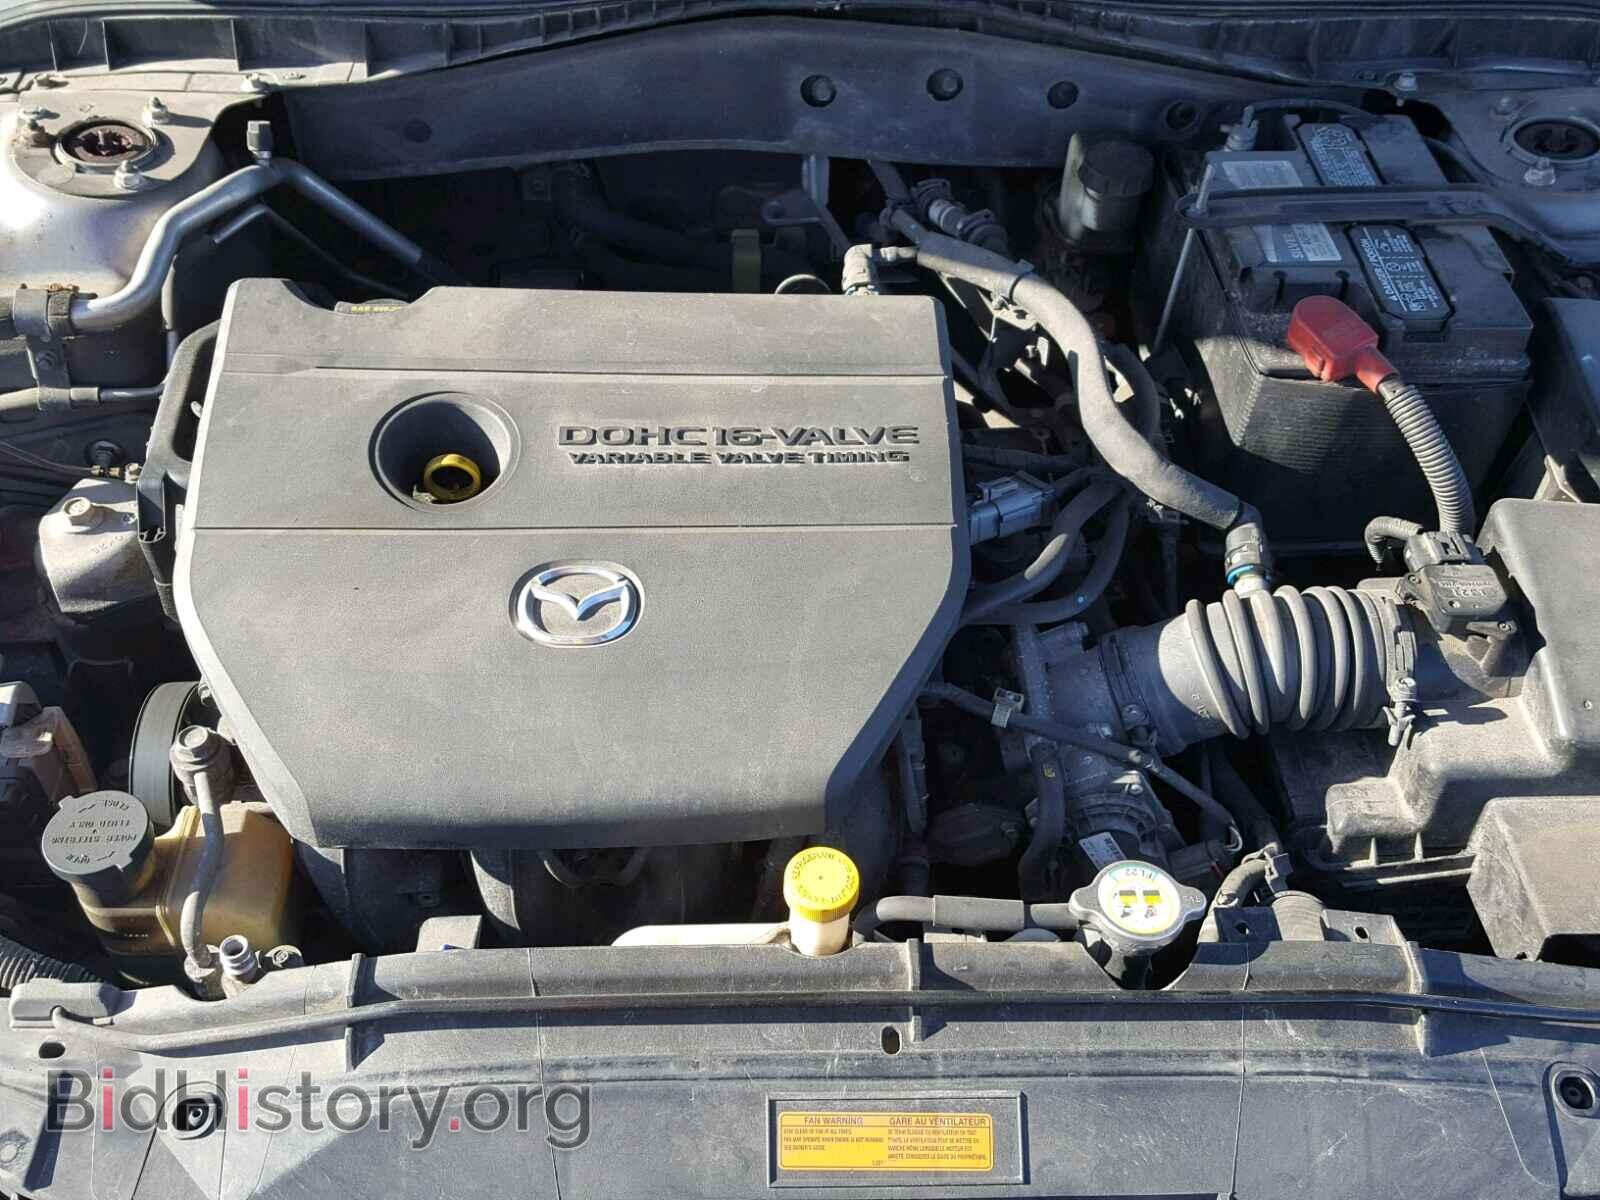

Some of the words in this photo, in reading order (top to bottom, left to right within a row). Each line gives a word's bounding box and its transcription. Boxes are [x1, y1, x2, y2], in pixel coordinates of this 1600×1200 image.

[558, 425, 708, 447] DOHC
[712, 424, 920, 447] 16-VALVE
[568, 451, 712, 465] VARIABLE
[715, 451, 806, 465] VALVE
[808, 450, 911, 464] TIMING
[804, 1116, 822, 1126] FAN
[823, 1116, 864, 1126] WARNING
[889, 1117, 913, 1127] GARE
[914, 1117, 928, 1127] AU
[929, 1116, 987, 1127] VENTILATEUR
